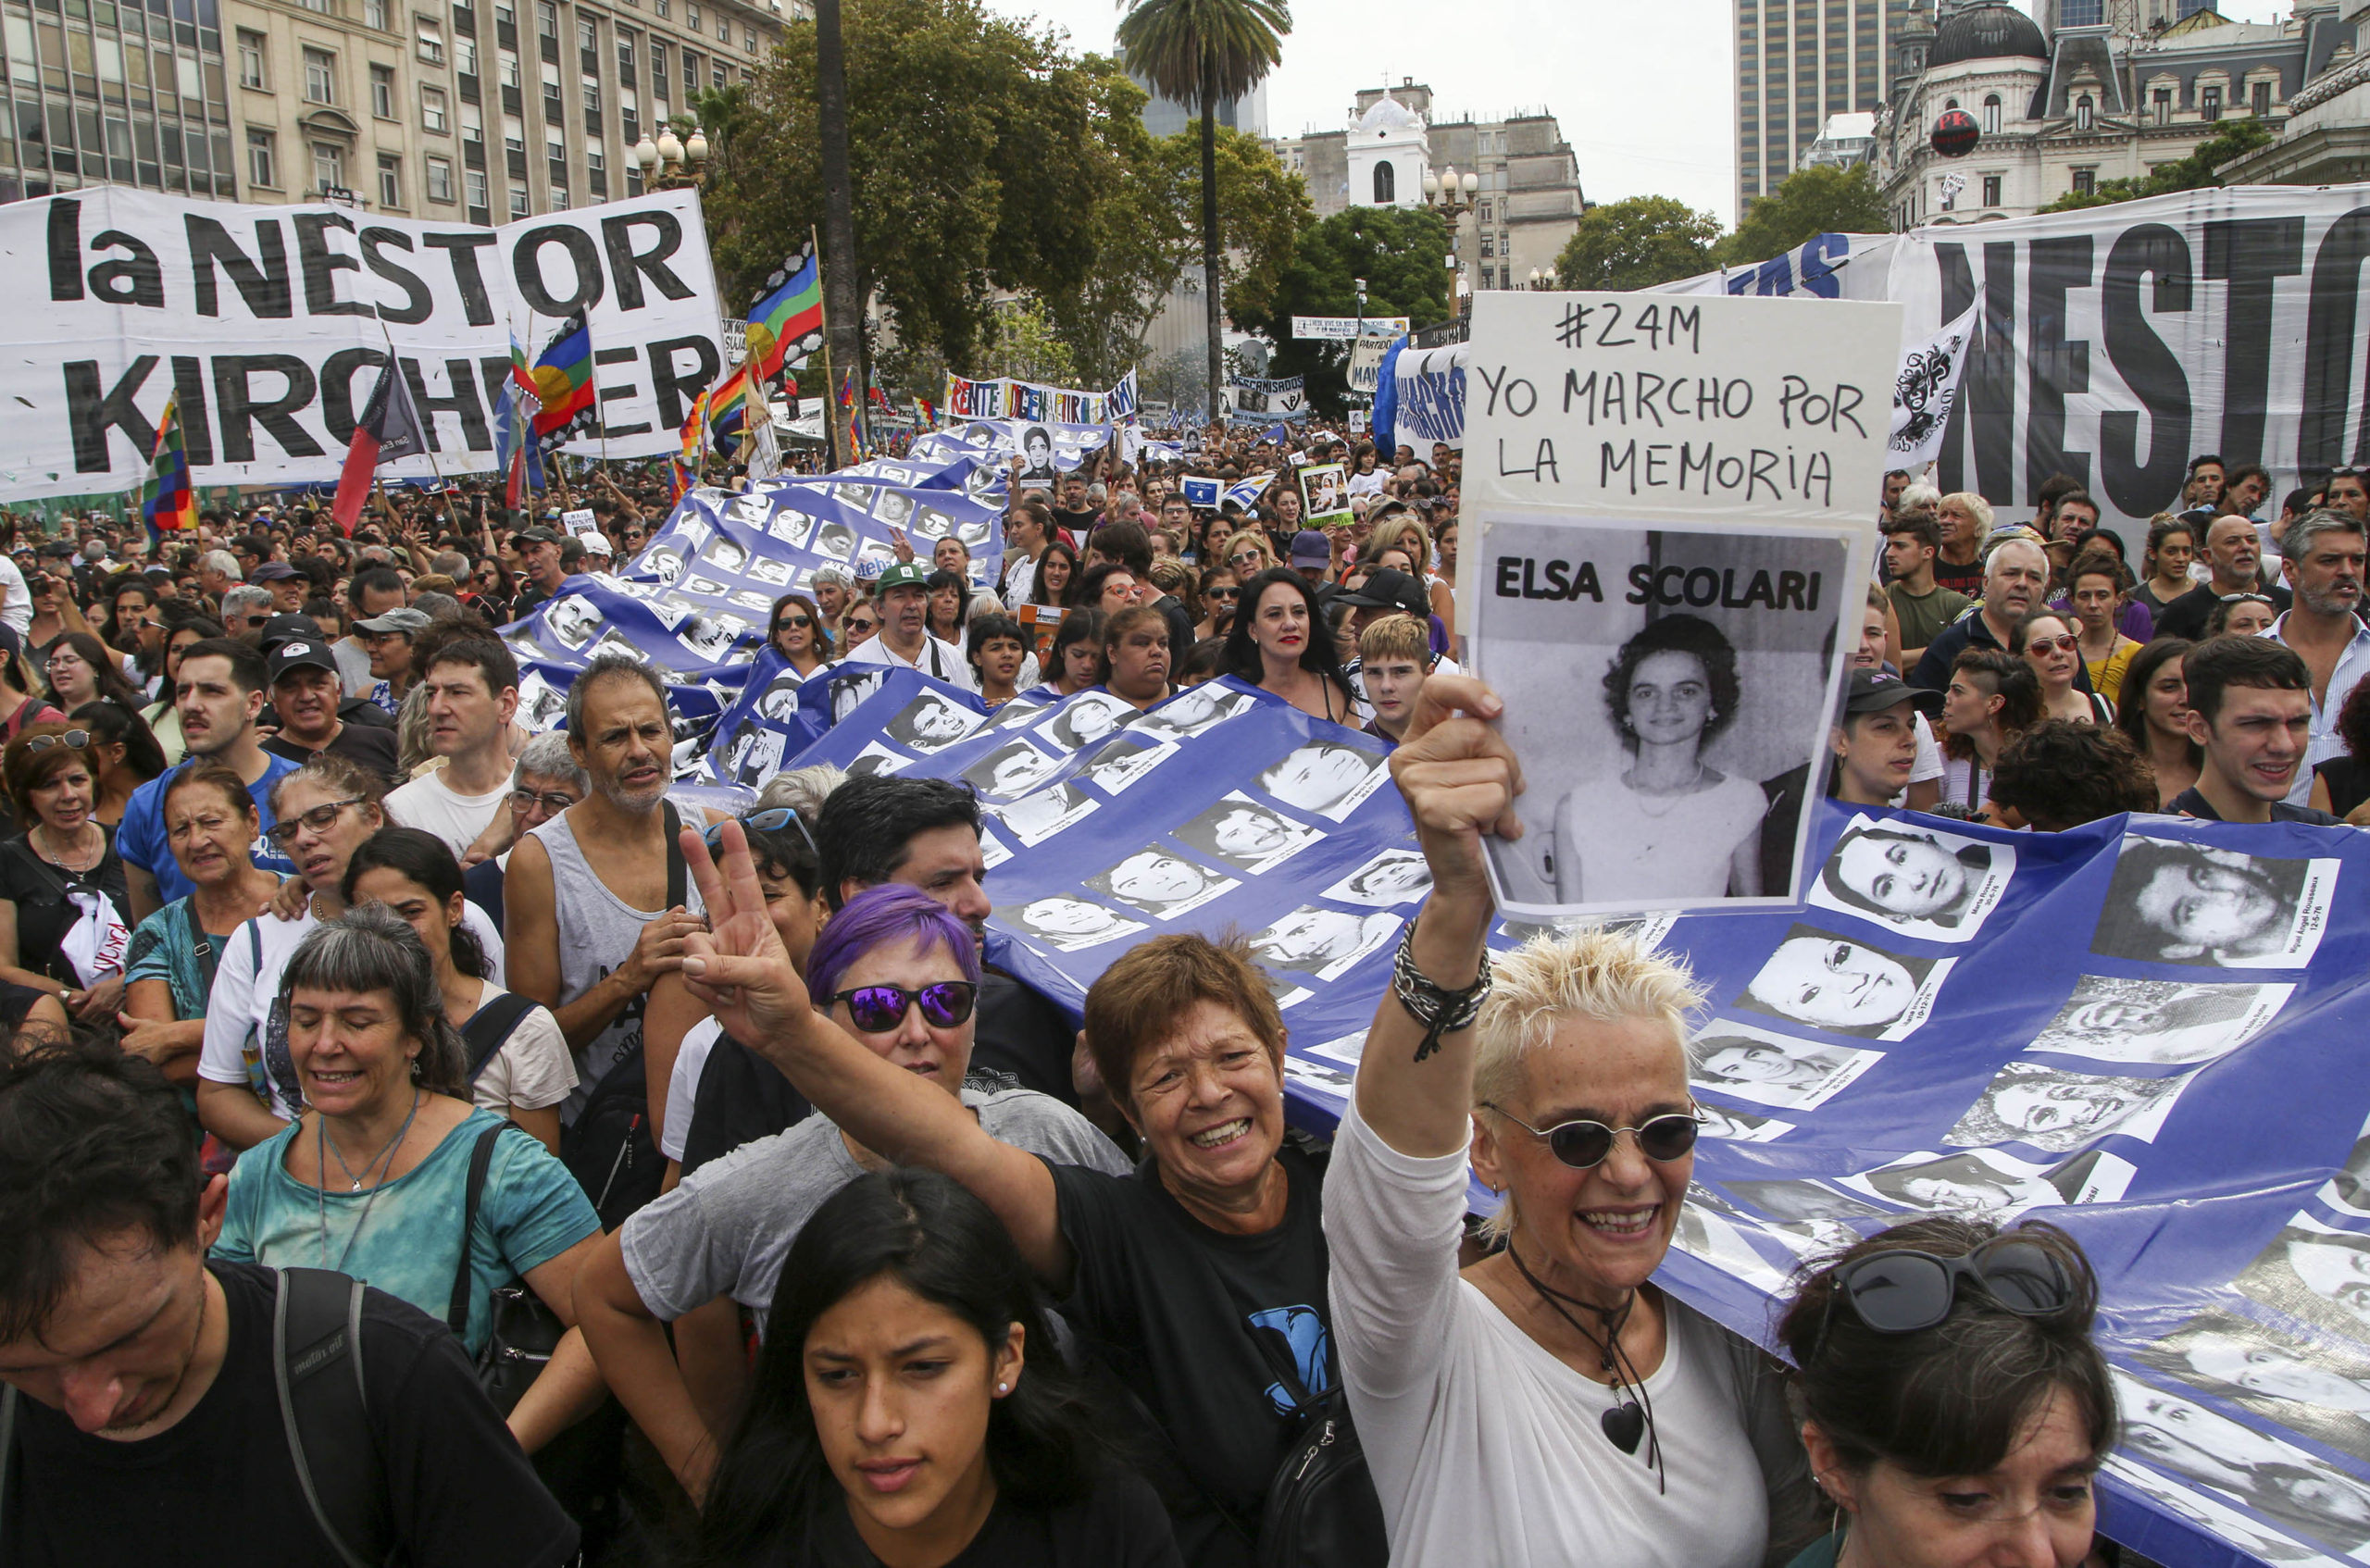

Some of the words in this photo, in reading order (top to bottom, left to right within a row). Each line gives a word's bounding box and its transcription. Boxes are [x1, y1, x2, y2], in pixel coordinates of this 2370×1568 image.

[185, 209, 697, 325] NESTOR
[1358, 340, 1391, 350] PARTIDO
[1555, 302, 1700, 354] #24M
[1231, 374, 1304, 393] DESCAMISADOS
[1477, 366, 1537, 417] YO
[1564, 368, 1753, 427] MARCHO
[1779, 375, 1868, 439] POR
[1499, 439, 1559, 483] LA
[1495, 556, 1603, 603] ELSA
[1626, 564, 1822, 611] SCOLARI
[1971, 898, 1984, 915] Marta
[2302, 876, 2319, 915] Rousseaux
[2310, 905, 2323, 931] 12-5-76
